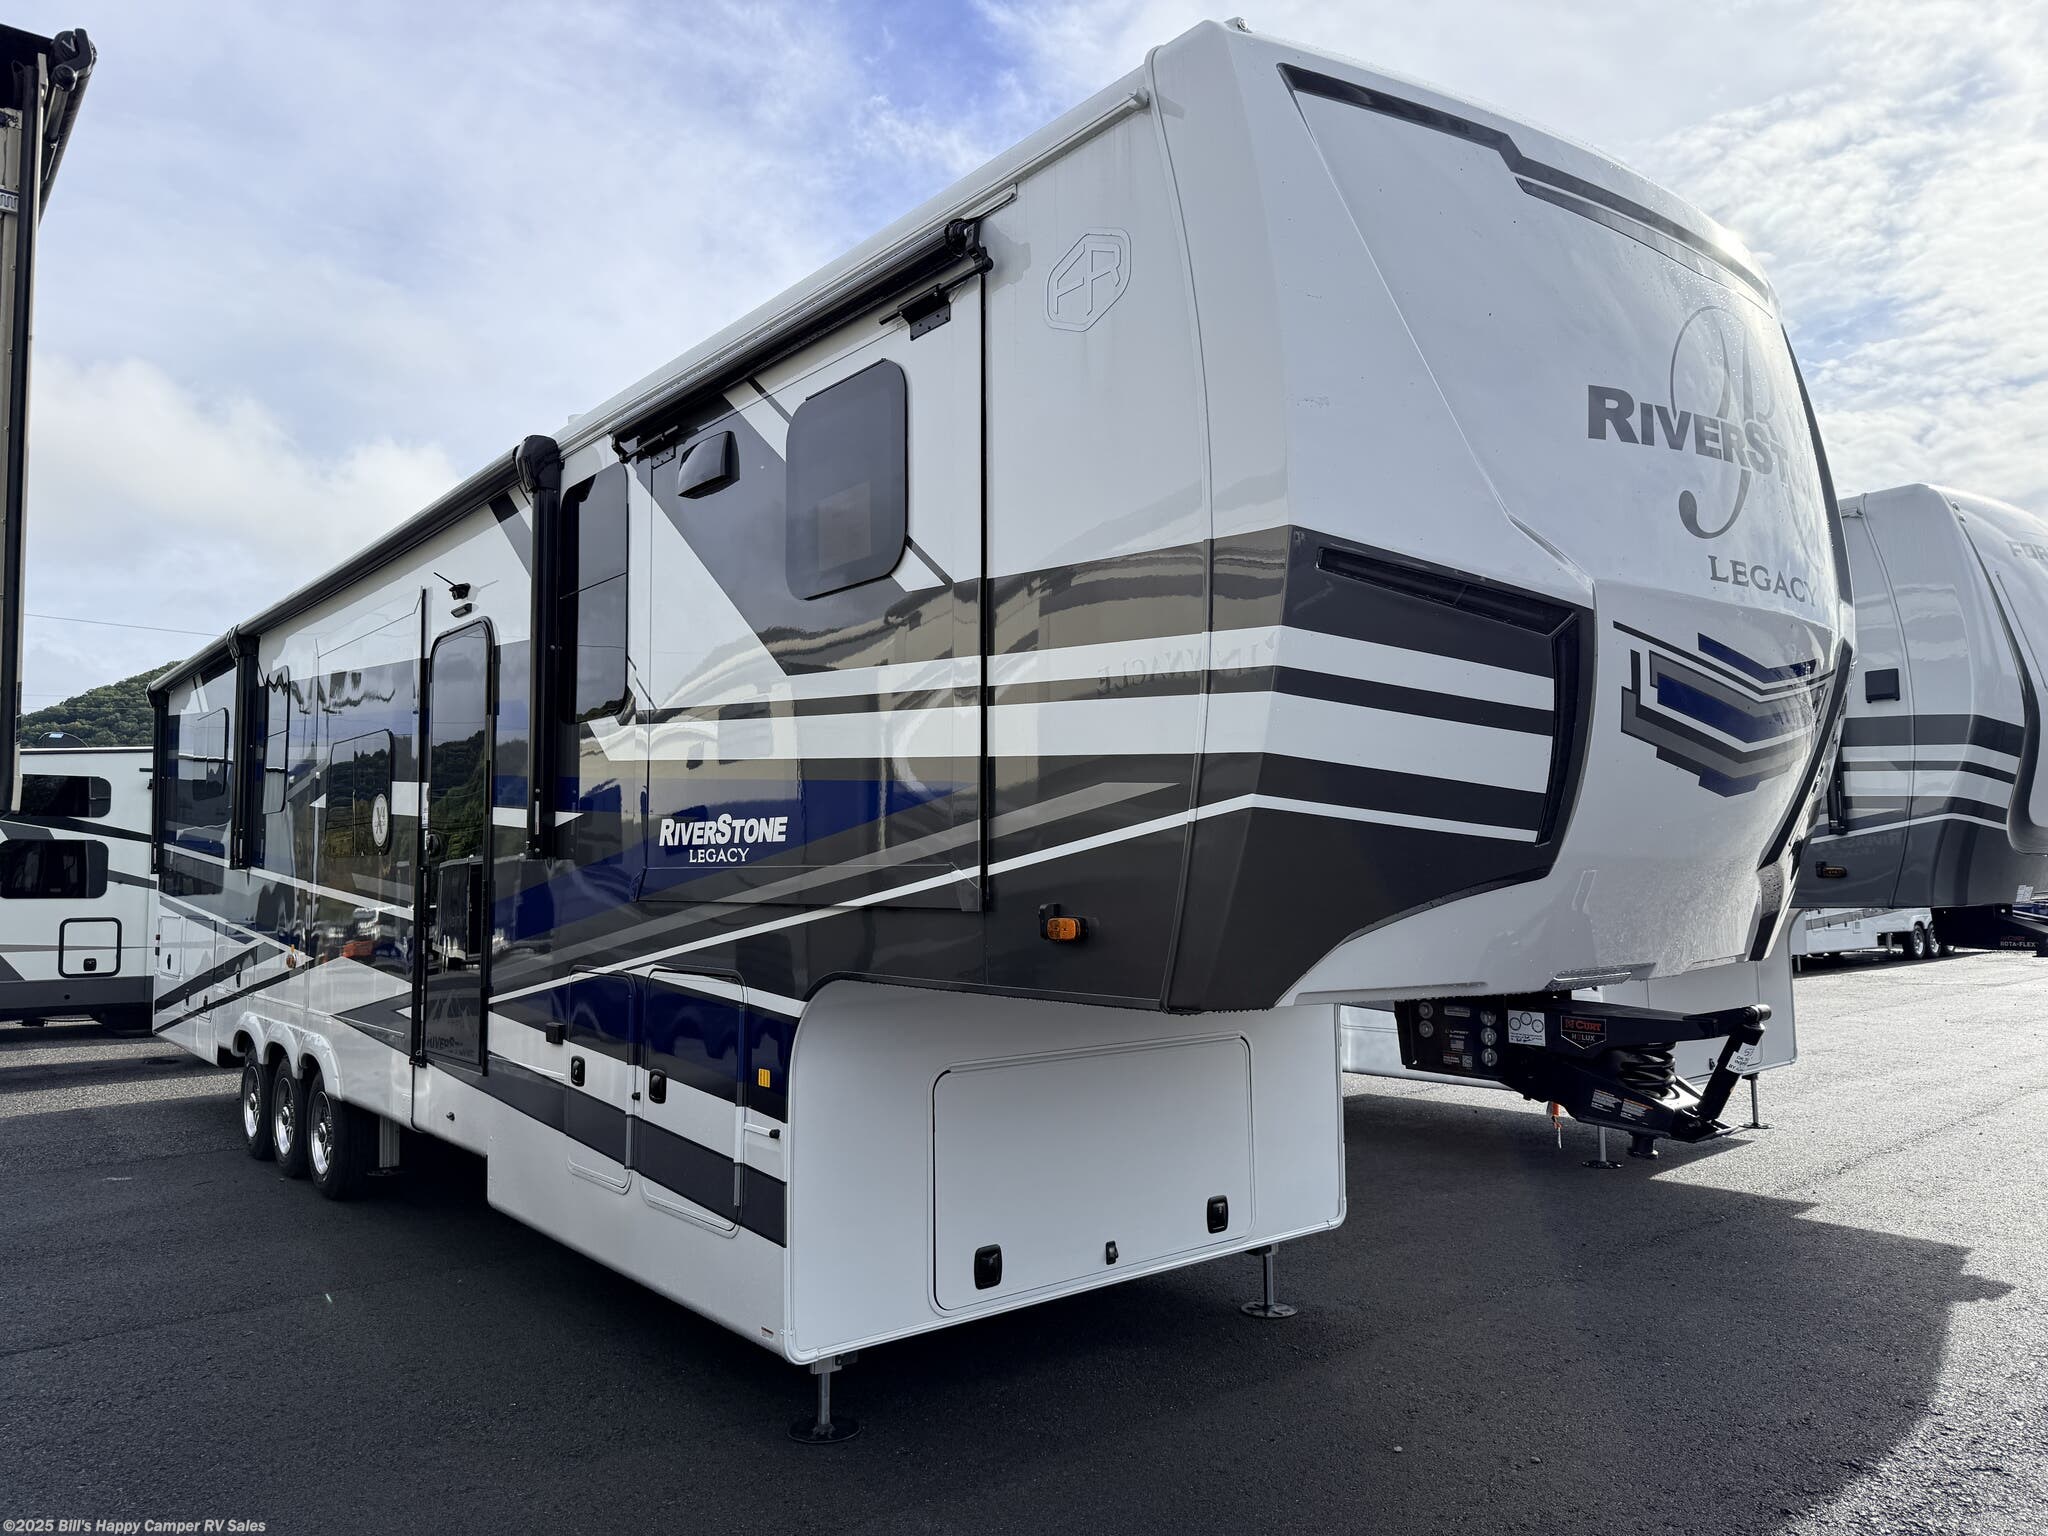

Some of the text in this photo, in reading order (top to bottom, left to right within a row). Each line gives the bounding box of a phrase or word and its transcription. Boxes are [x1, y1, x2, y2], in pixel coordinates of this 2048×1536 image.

[1707, 555, 1818, 607] LEGACY
[659, 813, 789, 847] RIVERSTONE
[689, 848, 750, 863] LEGACY
